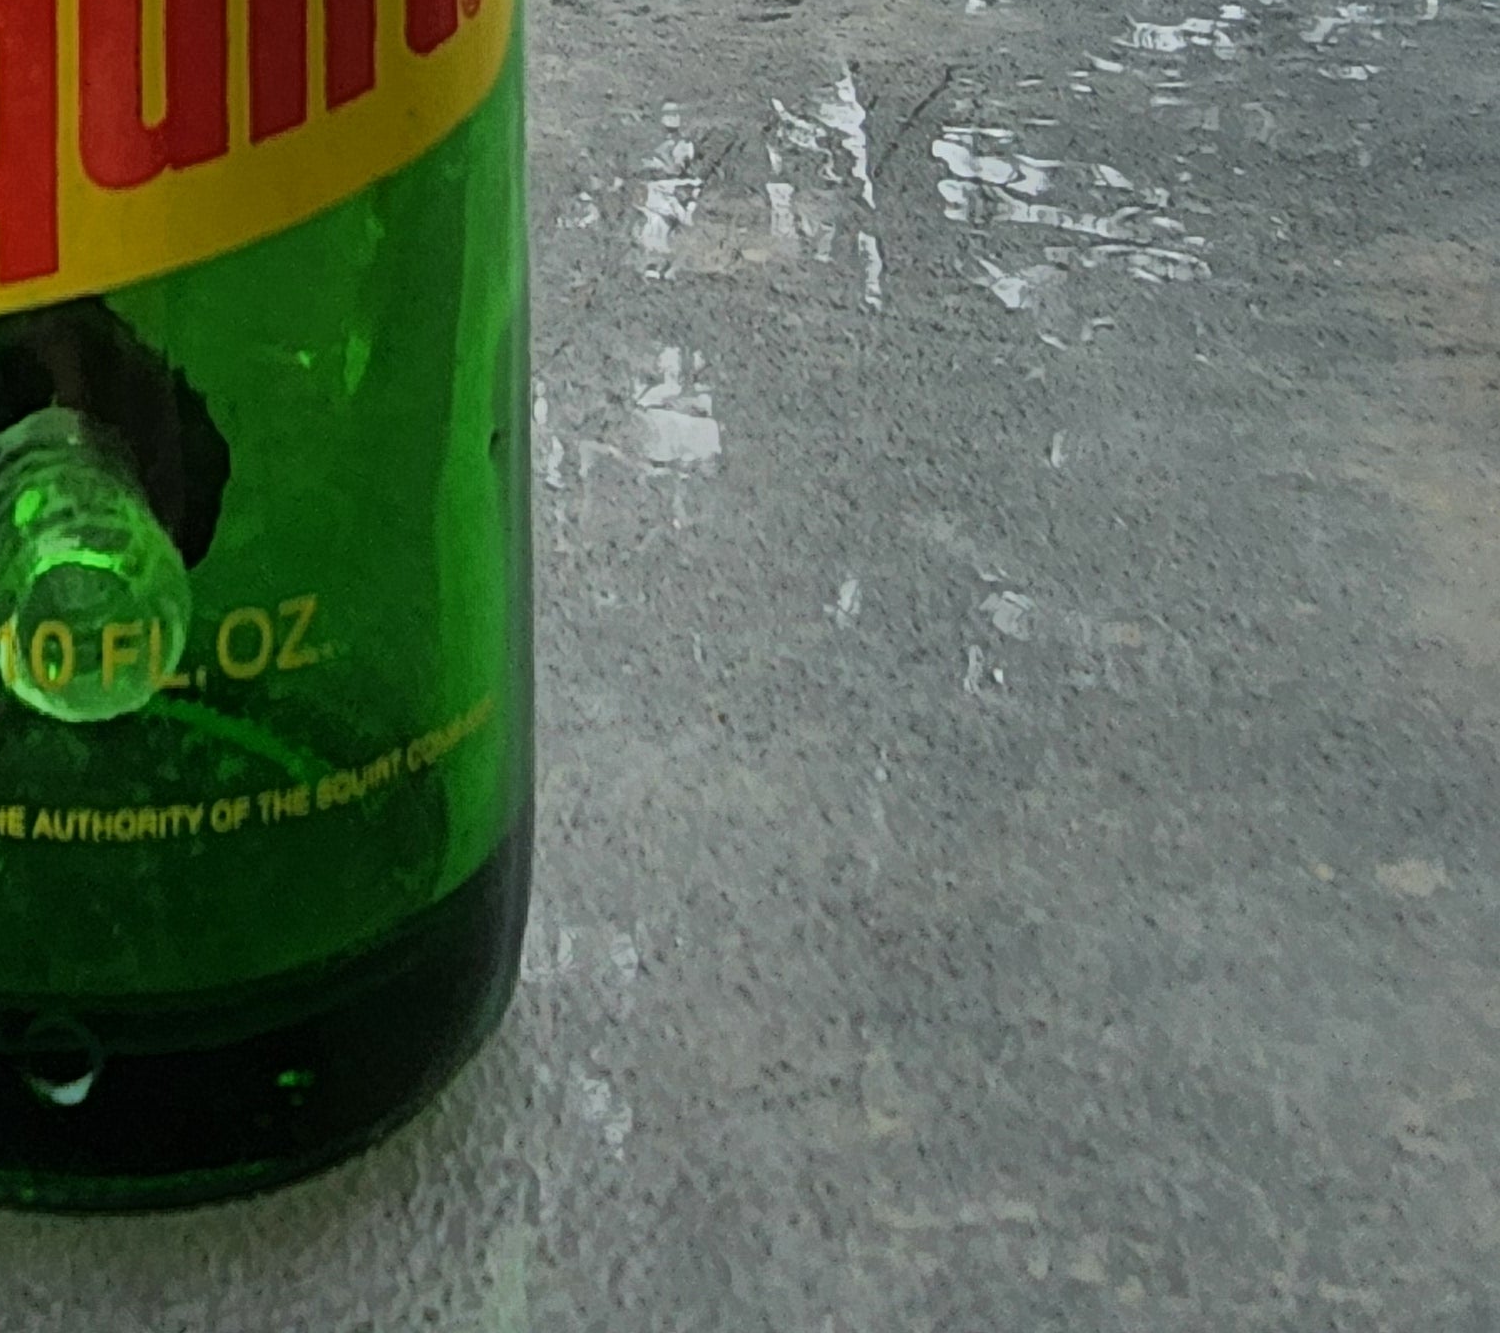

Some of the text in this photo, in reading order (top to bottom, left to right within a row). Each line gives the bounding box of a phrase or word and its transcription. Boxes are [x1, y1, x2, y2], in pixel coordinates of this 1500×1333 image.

[32, 801, 205, 843] AUTHORITY
[211, 795, 250, 834] OF
[257, 781, 311, 825] THE
